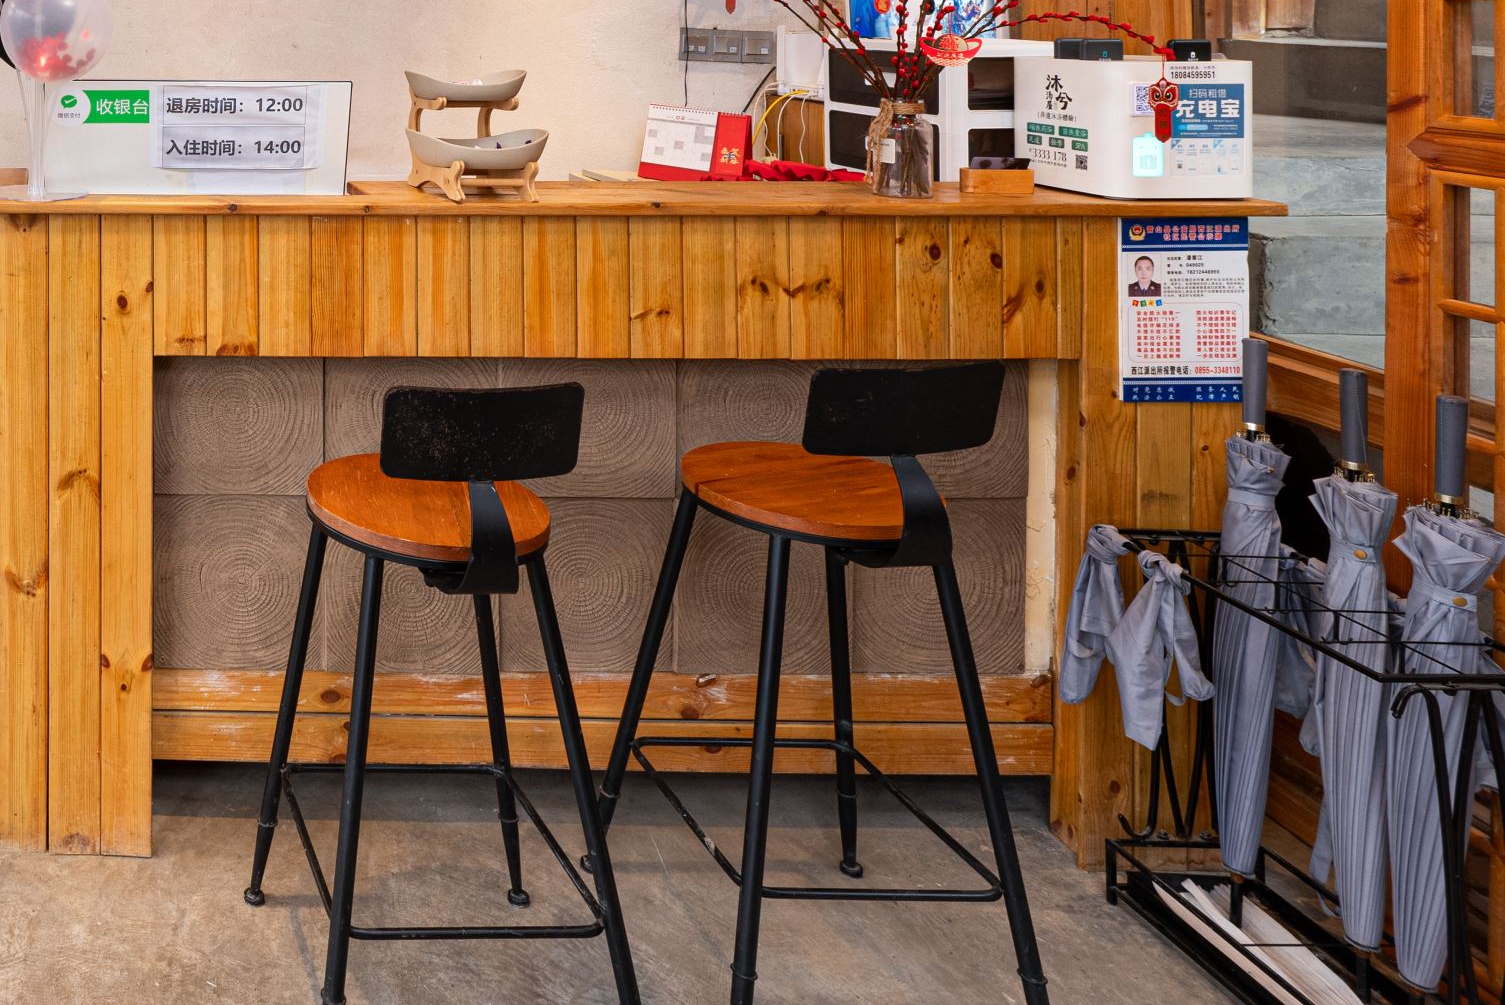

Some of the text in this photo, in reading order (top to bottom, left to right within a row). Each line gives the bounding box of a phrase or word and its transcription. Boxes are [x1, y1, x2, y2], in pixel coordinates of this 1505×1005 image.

[1170, 71, 1216, 79] 18084595951
[1188, 88, 1227, 99] 扫码租借
[96, 99, 149, 116] 收银台
[255, 97, 303, 113] 12:00
[1175, 99, 1240, 118] 充电宝
[253, 140, 302, 155] 14:00
[1075, 142, 1086, 150] SPA
[1146, 224, 1240, 233] 雷山县公安局西江派出所
[1163, 232, 1223, 241] 社区民警公示牌
[1131, 366, 1240, 375] 西江派出所报警电话： 0855-3348110
